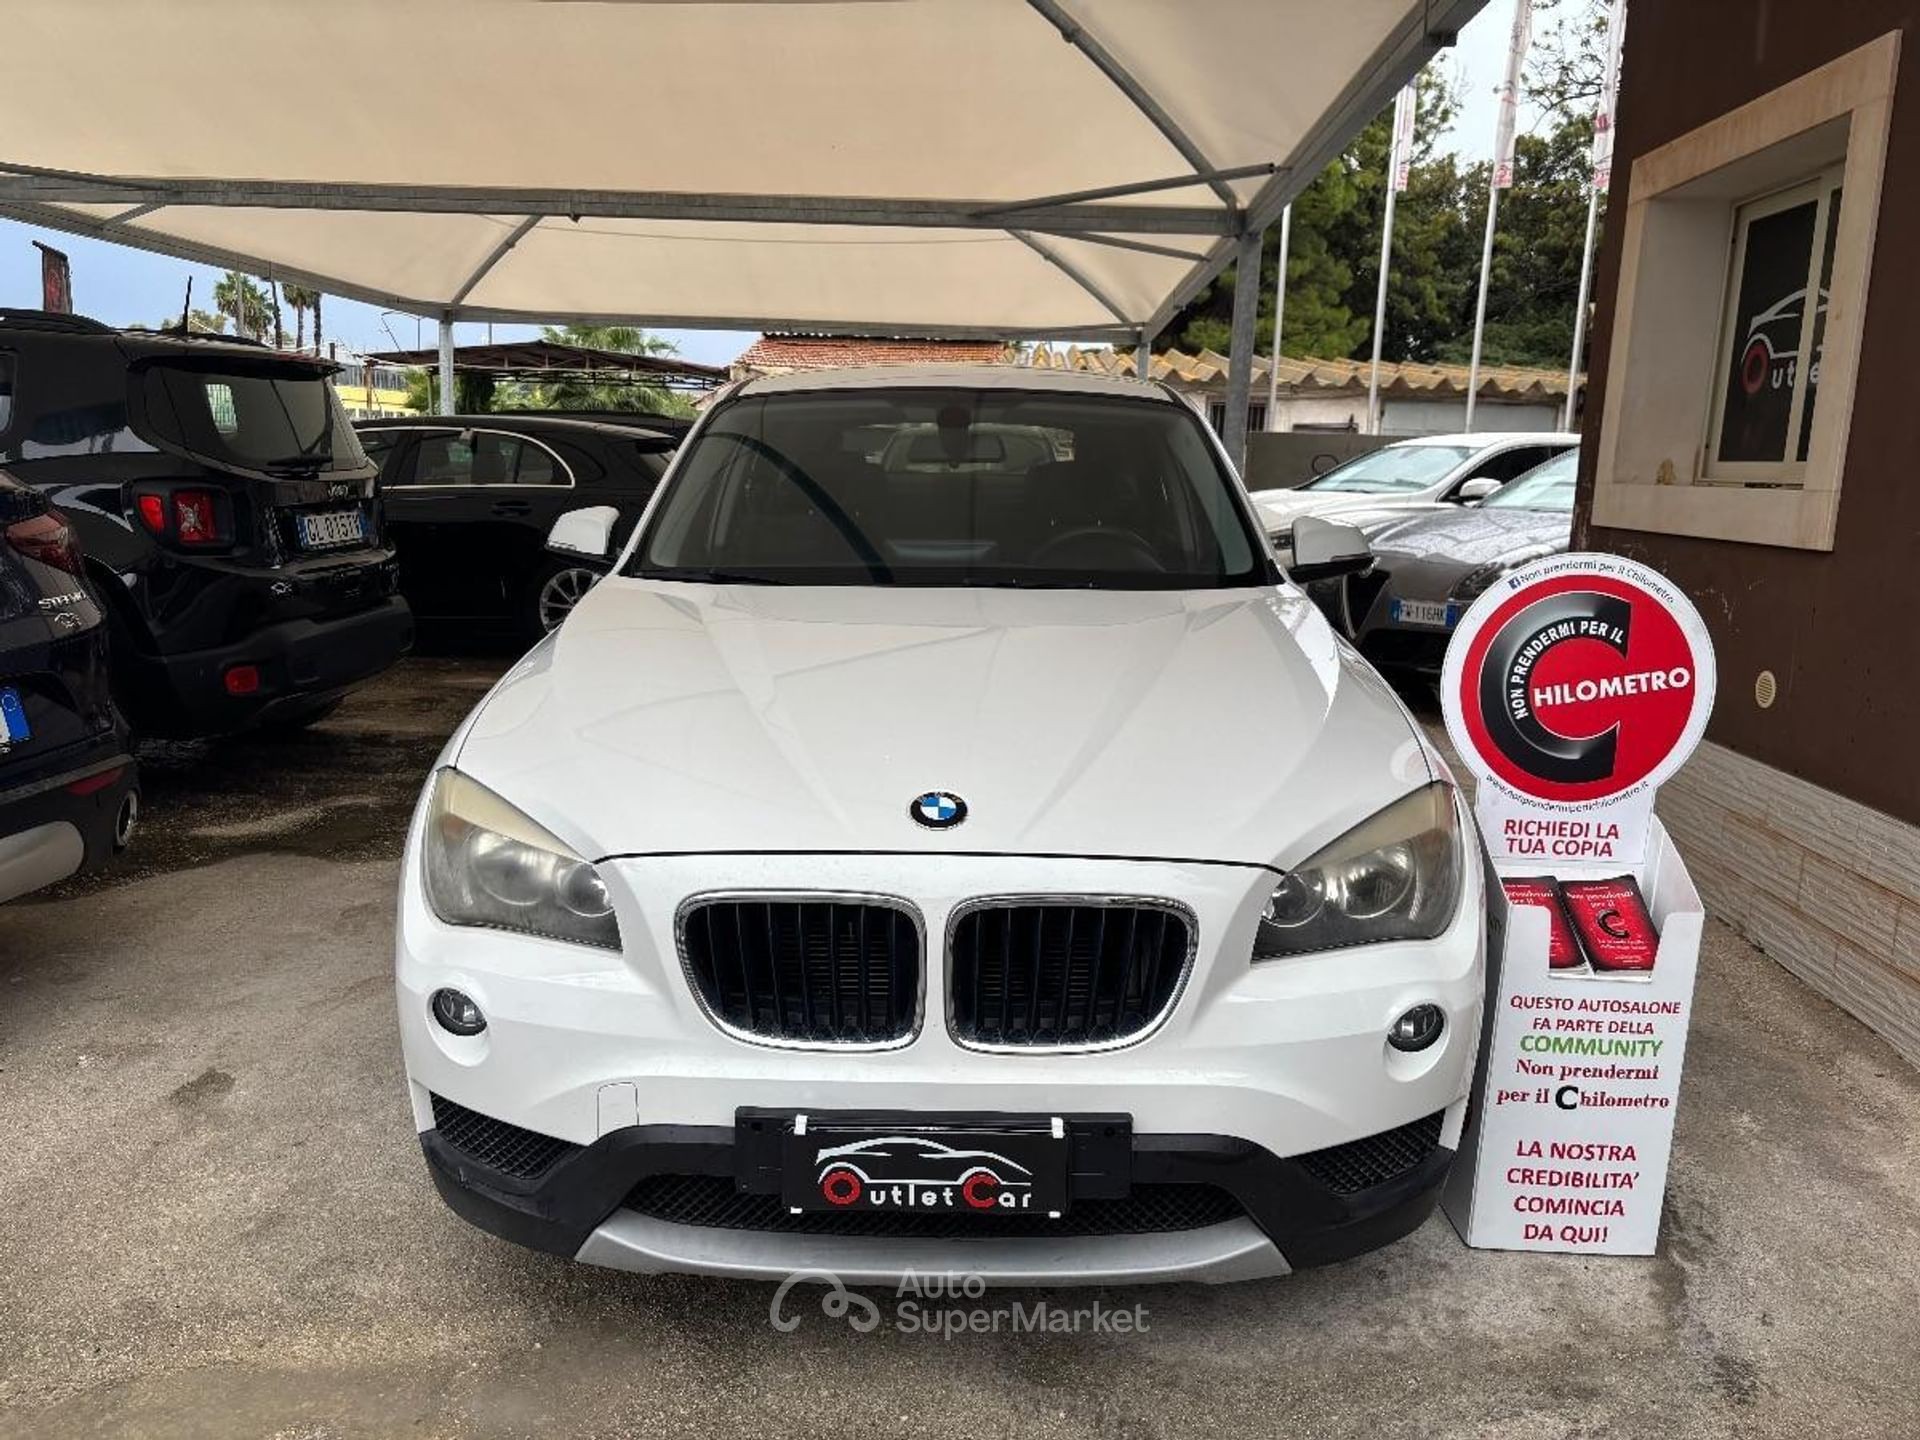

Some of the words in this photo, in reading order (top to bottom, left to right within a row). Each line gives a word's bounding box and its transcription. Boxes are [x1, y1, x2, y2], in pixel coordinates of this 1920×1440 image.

[1580, 620, 1608, 637] PER
[1611, 628, 1625, 644] IL
[1511, 621, 1576, 685] PRENDERMI
[1510, 687, 1529, 720] NON
[1504, 819, 1590, 838] RICHIEDI
[1597, 822, 1620, 839] LA
[1507, 838, 1546, 855] TUA
[1552, 840, 1614, 857] COPIA
[1510, 995, 1574, 1012] QUESTO
[1577, 998, 1681, 1015] AUTOSALONE
[1532, 1017, 1551, 1031] FA
[1556, 1018, 1603, 1033] PARTE
[1608, 1020, 1655, 1035] DELLA
[1520, 1035, 1663, 1058] COMMUNITY
[1516, 1059, 1554, 1077] Non
[1560, 1064, 1660, 1081] prendermi
[1496, 1088, 1530, 1105] per
[1534, 1087, 1549, 1104] il
[1555, 1085, 1670, 1110] Chilometro
[1516, 1140, 1543, 1158] LA
[1550, 1142, 1637, 1162] NOSTRA
[822, 1169, 954, 1208] Outlet
[962, 1172, 1032, 1209] Car
[1513, 1195, 1625, 1217] COMINCIA
[1523, 1224, 1554, 1242] DA
[1560, 1225, 1608, 1244] QUI!
